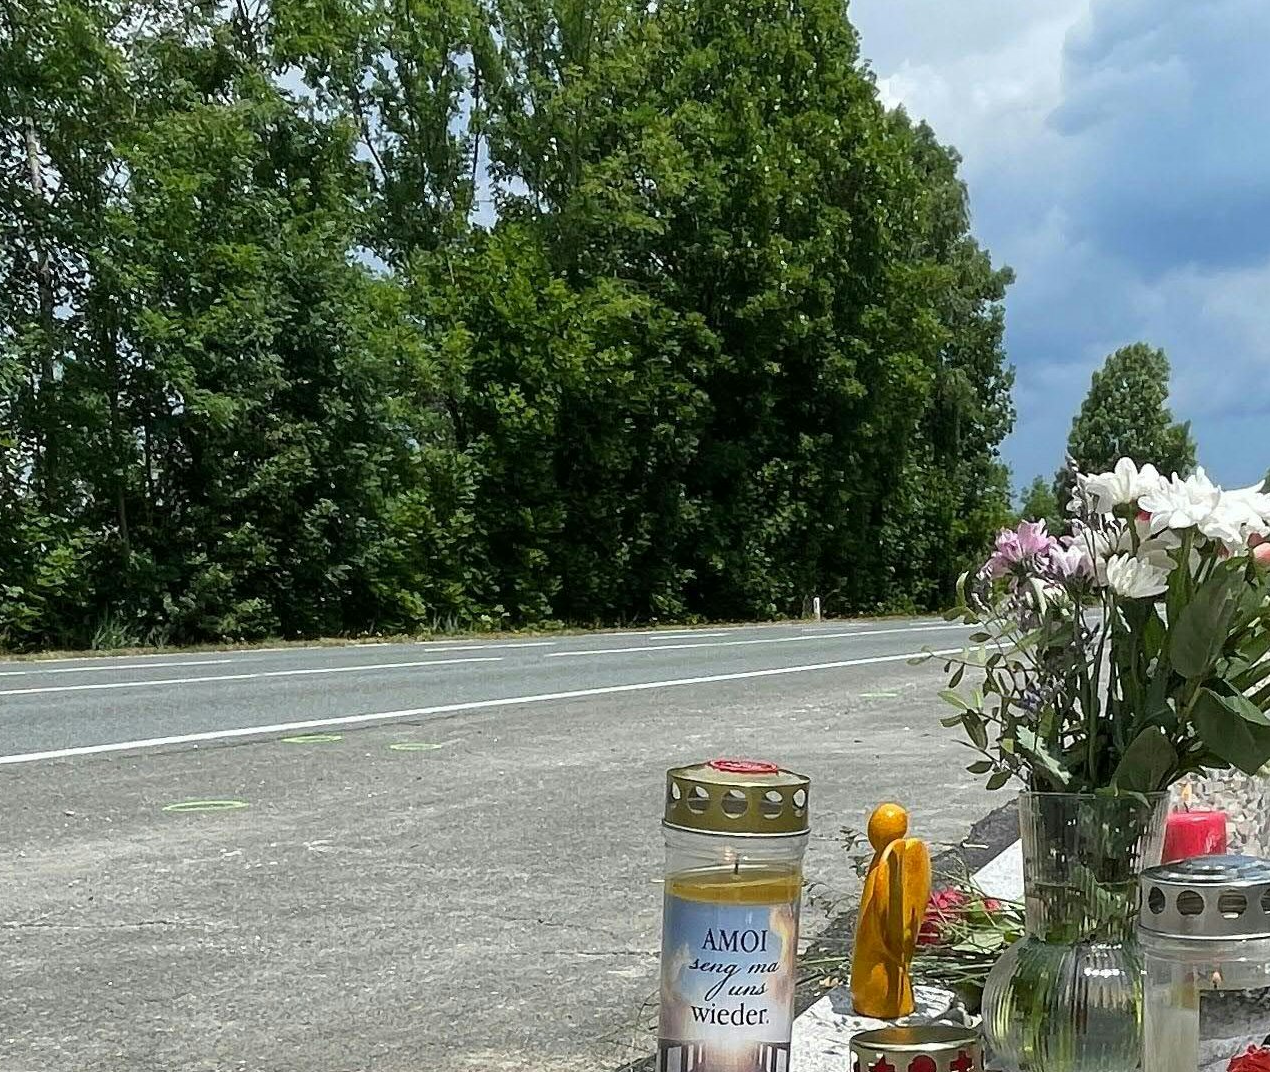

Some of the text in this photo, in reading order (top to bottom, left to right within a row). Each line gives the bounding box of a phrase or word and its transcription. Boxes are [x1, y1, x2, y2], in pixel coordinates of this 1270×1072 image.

[701, 928, 768, 953] AMOI
[689, 958, 779, 1001] seng ma
[728, 982, 768, 996] uns
[690, 1002, 769, 1026] wieder.
